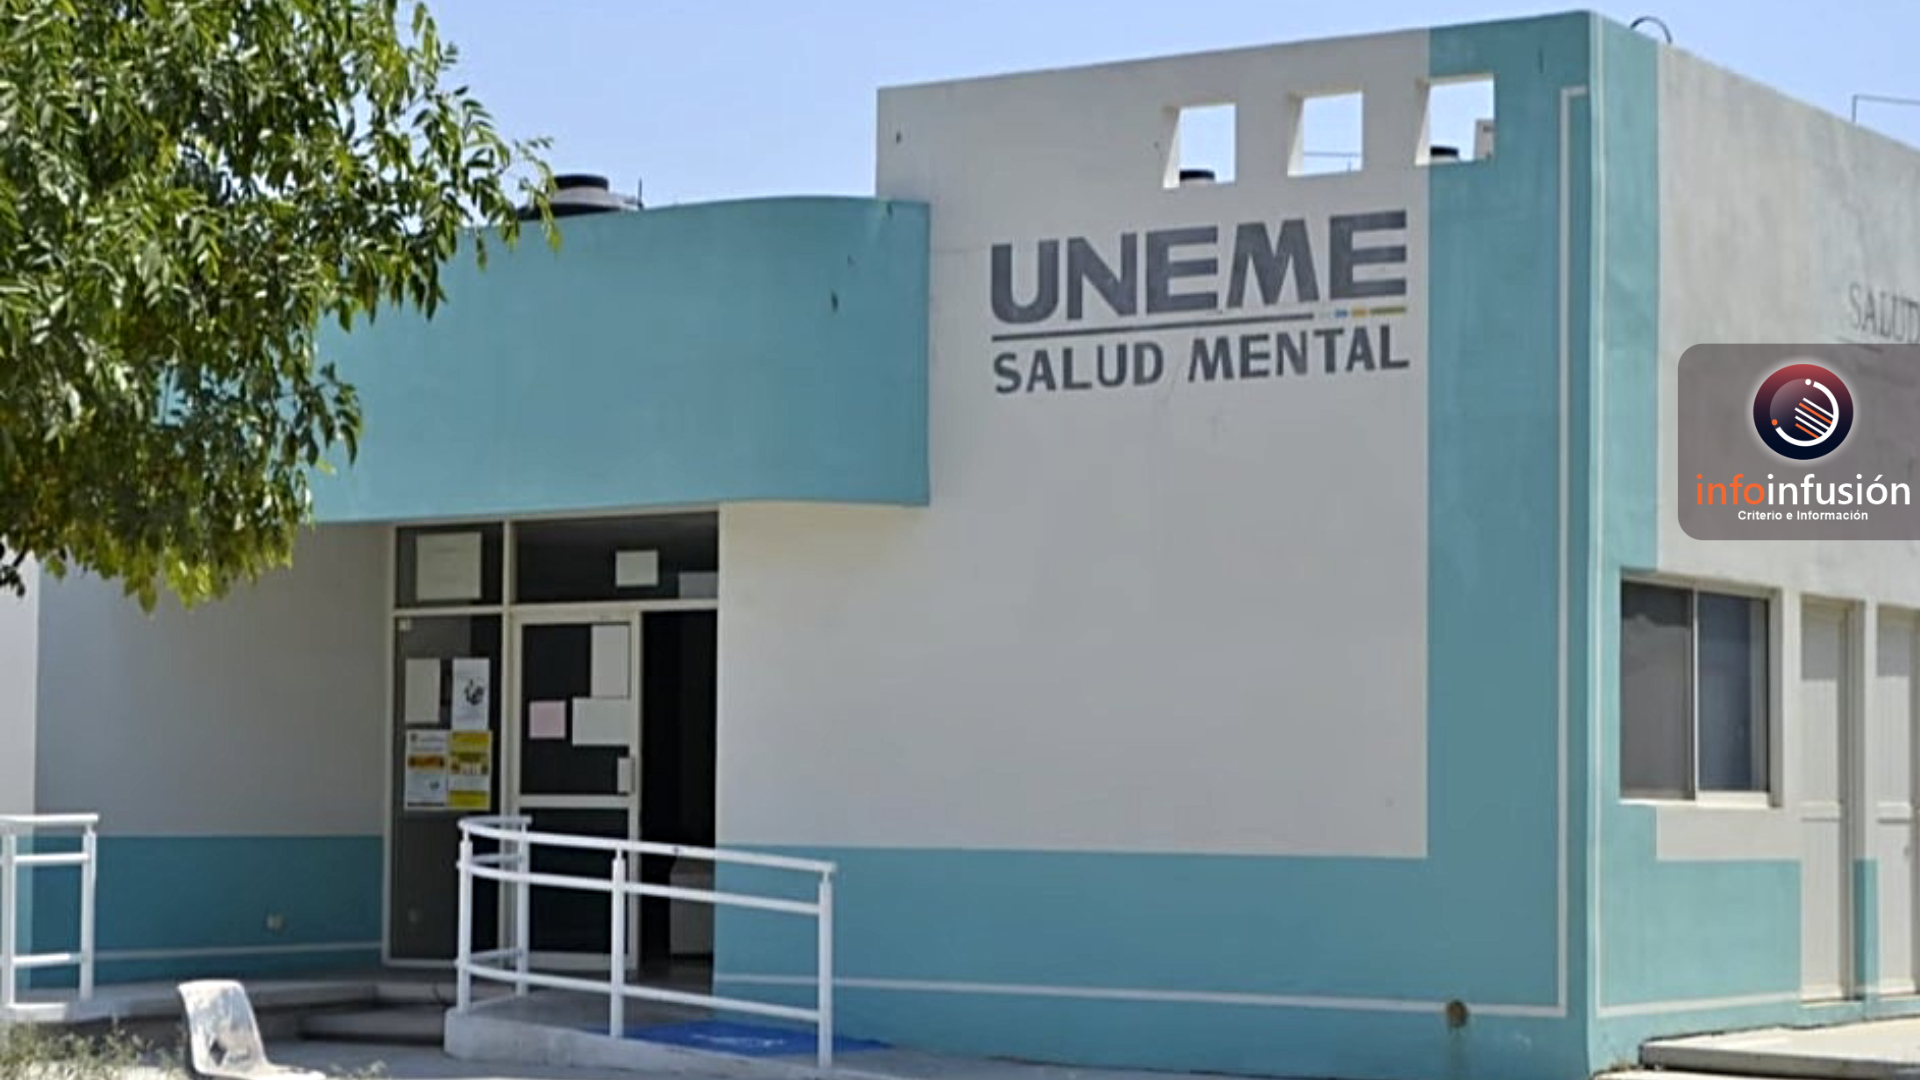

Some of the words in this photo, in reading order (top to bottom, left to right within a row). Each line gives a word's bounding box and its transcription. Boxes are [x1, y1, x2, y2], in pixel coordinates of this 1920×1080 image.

[991, 210, 1406, 324] UNEME
[1849, 282, 1920, 344] SALUD
[993, 341, 1164, 394] SALUD
[1188, 324, 1409, 383] MENTAL
